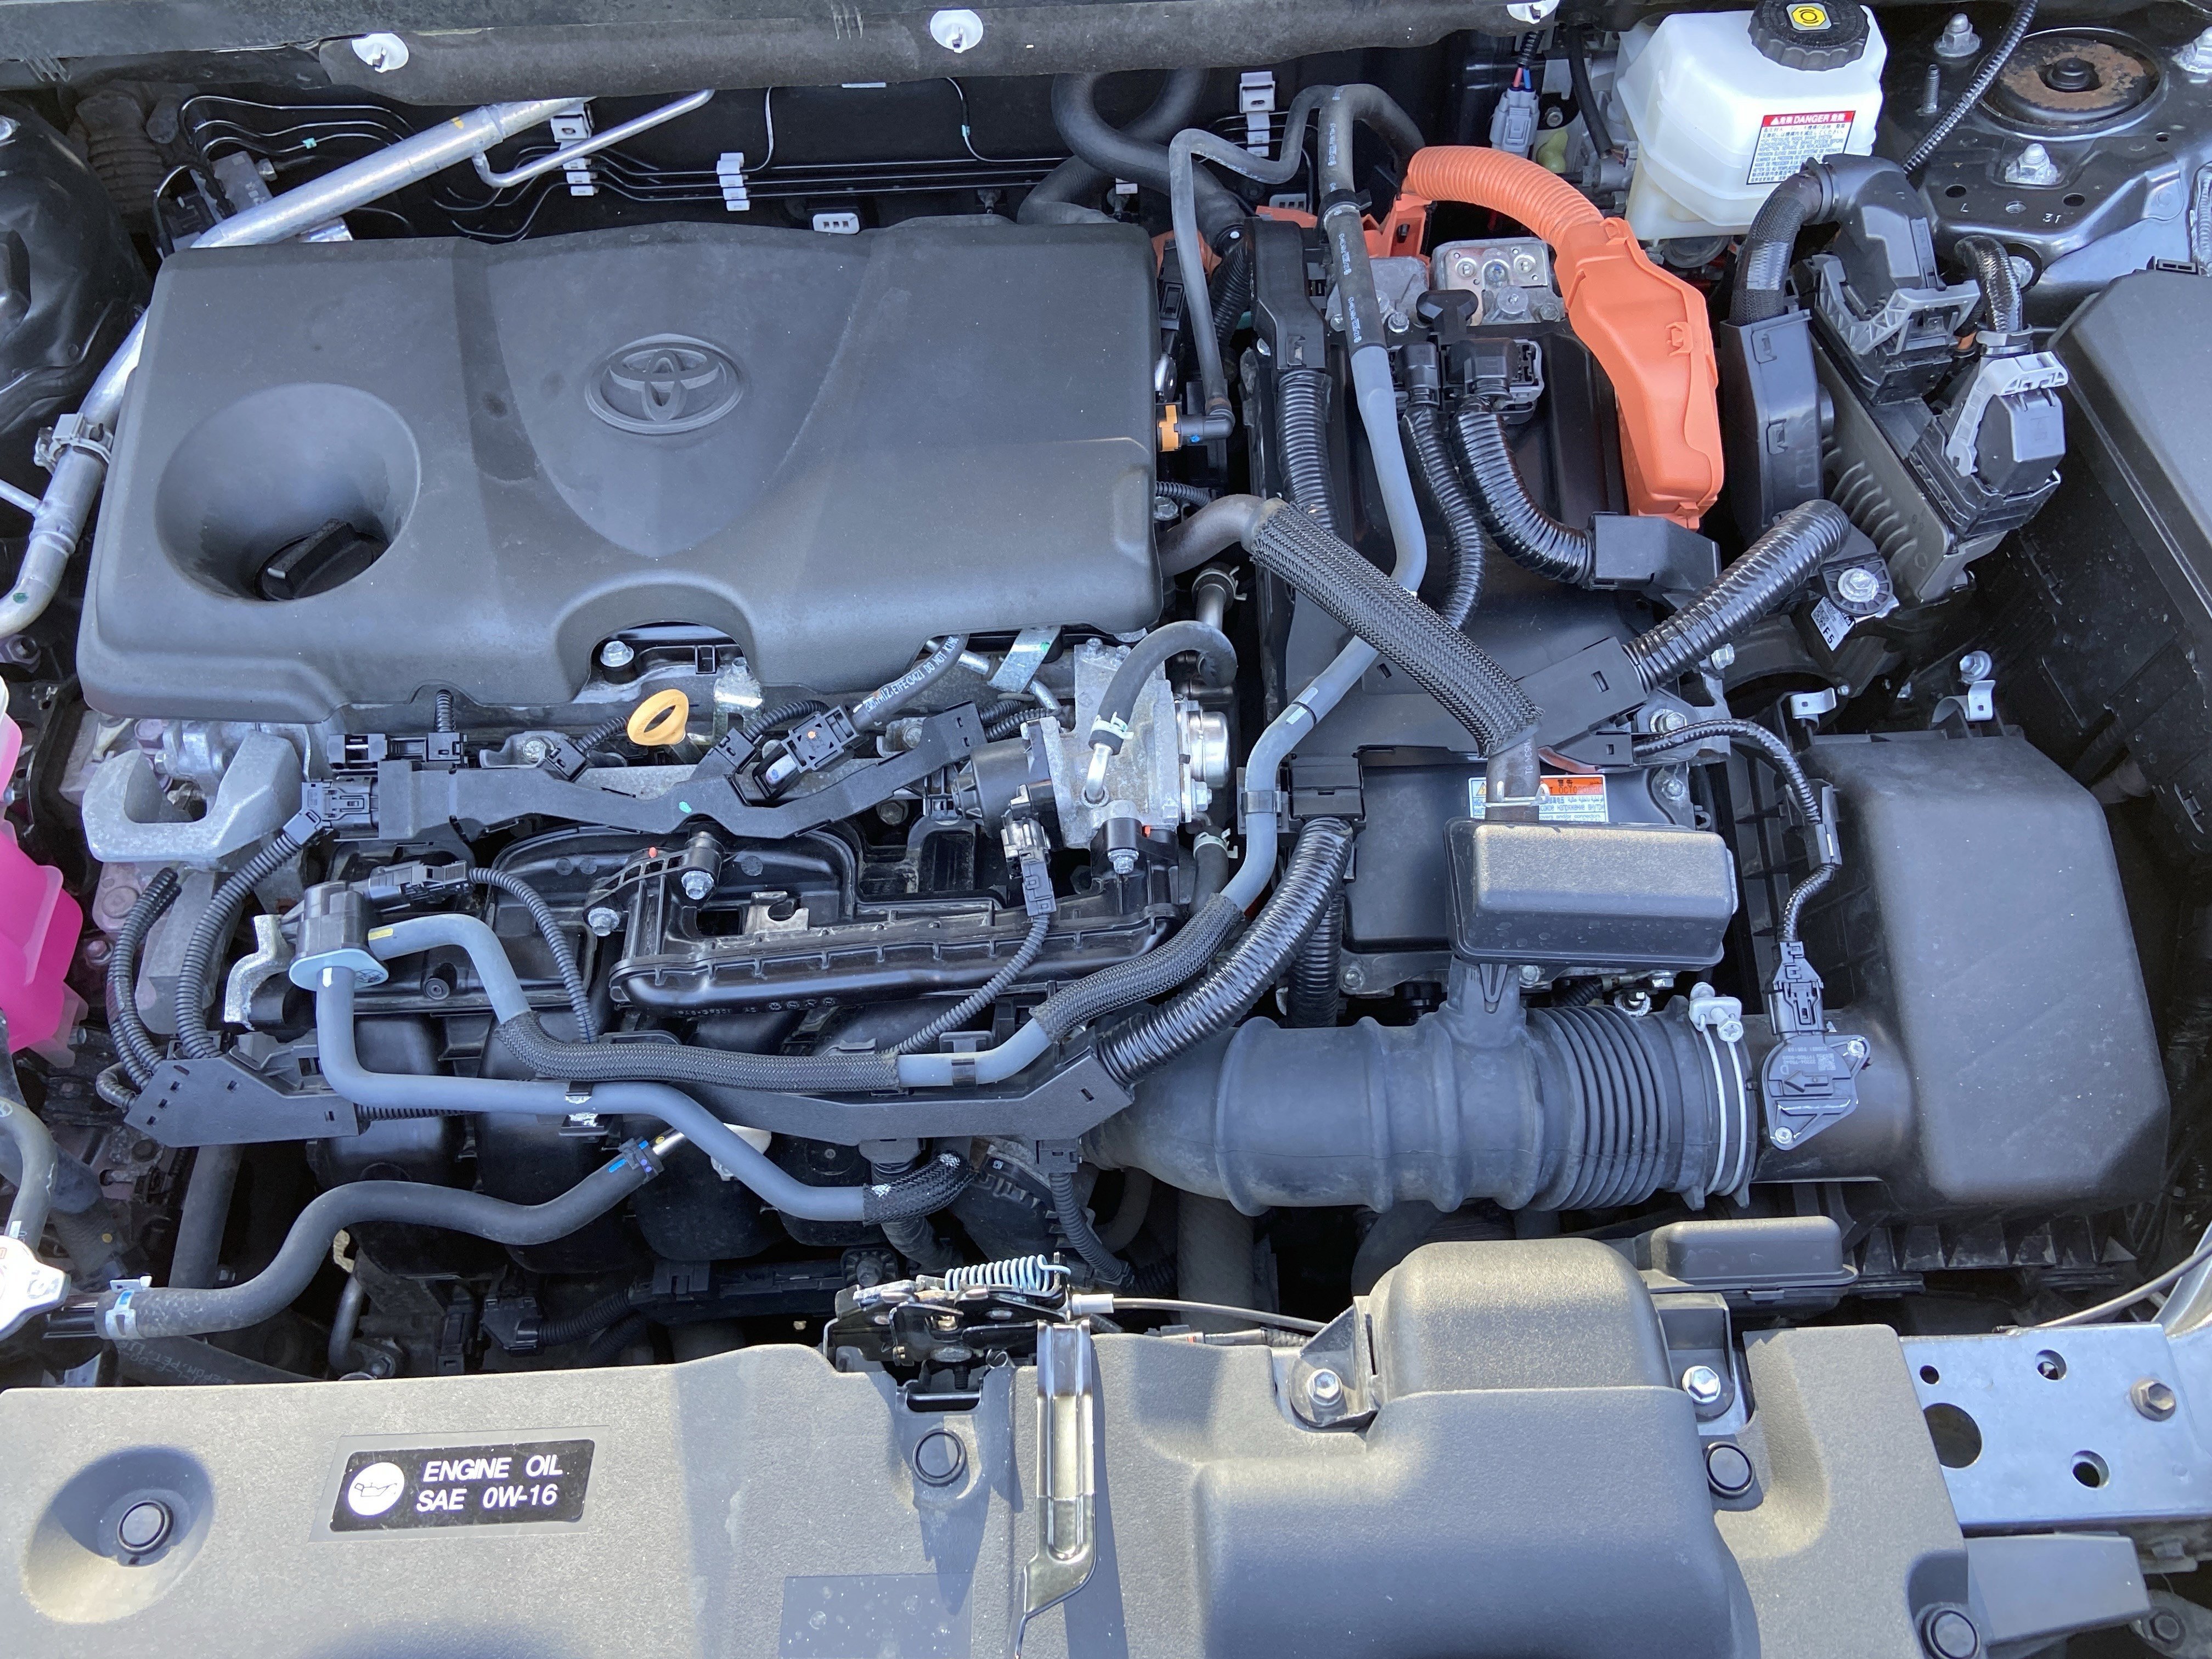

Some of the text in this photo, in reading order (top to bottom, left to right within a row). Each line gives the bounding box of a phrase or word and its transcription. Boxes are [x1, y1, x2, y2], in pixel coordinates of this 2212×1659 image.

[1793, 114, 1830, 123] DANGER
[423, 1454, 563, 1482] ENGINE OIL
[416, 1483, 558, 1513] SAE 0W-16
